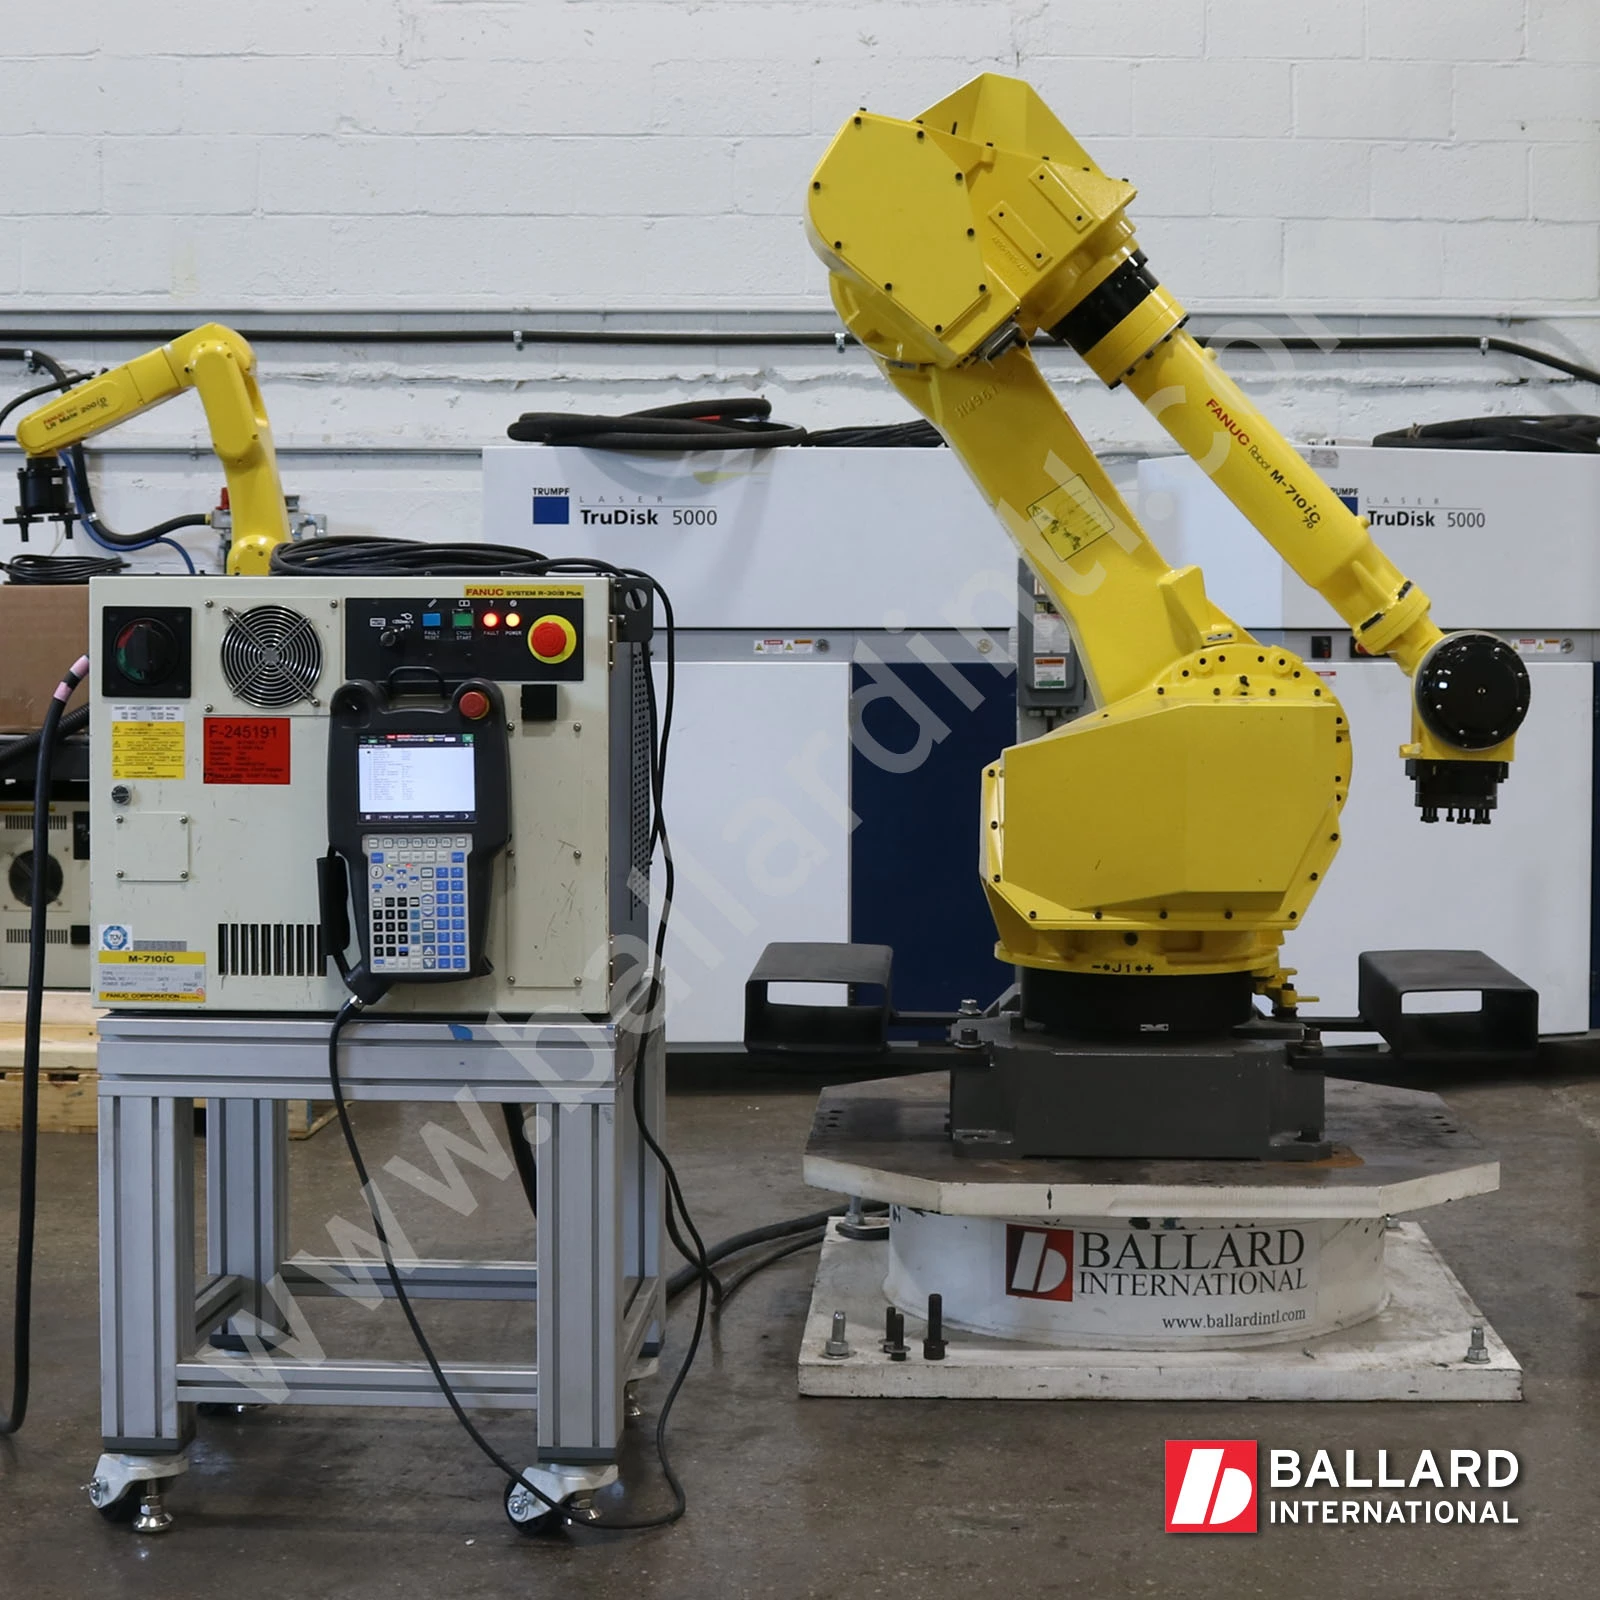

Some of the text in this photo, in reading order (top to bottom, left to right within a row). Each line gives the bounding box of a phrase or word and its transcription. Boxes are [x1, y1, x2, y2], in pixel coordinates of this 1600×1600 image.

[1206, 398, 1320, 524] FANUC Robot M-710iC
[532, 487, 570, 496] TRUMPF
[1330, 487, 1359, 496] UMPF
[579, 495, 664, 504] LASER
[1366, 496, 1439, 505] LASER
[579, 508, 718, 526] TruDisk 5000
[1367, 510, 1486, 528] TruDisk 5000
[465, 588, 504, 597] FANUC
[208, 724, 277, 739] F-245191
[128, 952, 175, 964] M-710iC
[1079, 1228, 1305, 1271] BALLARD
[1078, 1268, 1308, 1297] INTERNATIONAL
[1162, 1308, 1306, 1329] www.ballardintl.com
